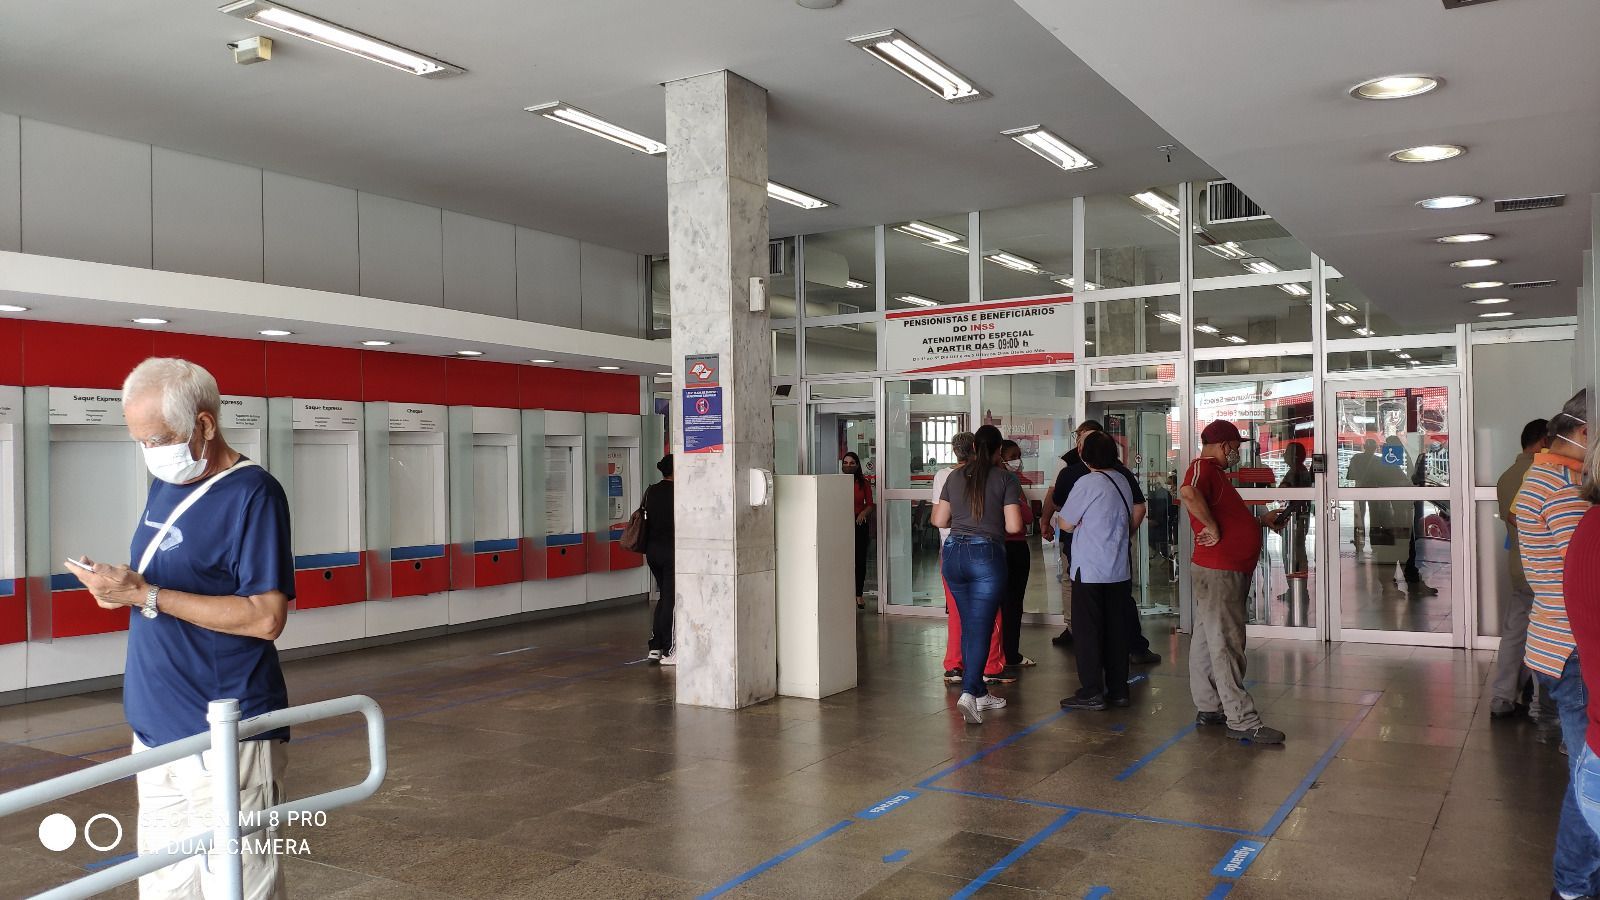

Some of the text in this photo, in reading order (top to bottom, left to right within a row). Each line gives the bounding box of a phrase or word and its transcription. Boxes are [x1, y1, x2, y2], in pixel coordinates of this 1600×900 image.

[903, 306, 1055, 328] PENSIONISTAS E BENEFICIÁRIOS
[953, 323, 995, 333] DO INSS
[922, 330, 1035, 345] ATENDIMENTO ESPECIAL
[936, 343, 972, 353] PARTIR
[974, 342, 995, 350] DAS
[997, 337, 1019, 350] 09:00
[73, 394, 95, 402] Saque
[868, 794, 910, 813] Entrada
[1223, 846, 1256, 872] Aguarde
